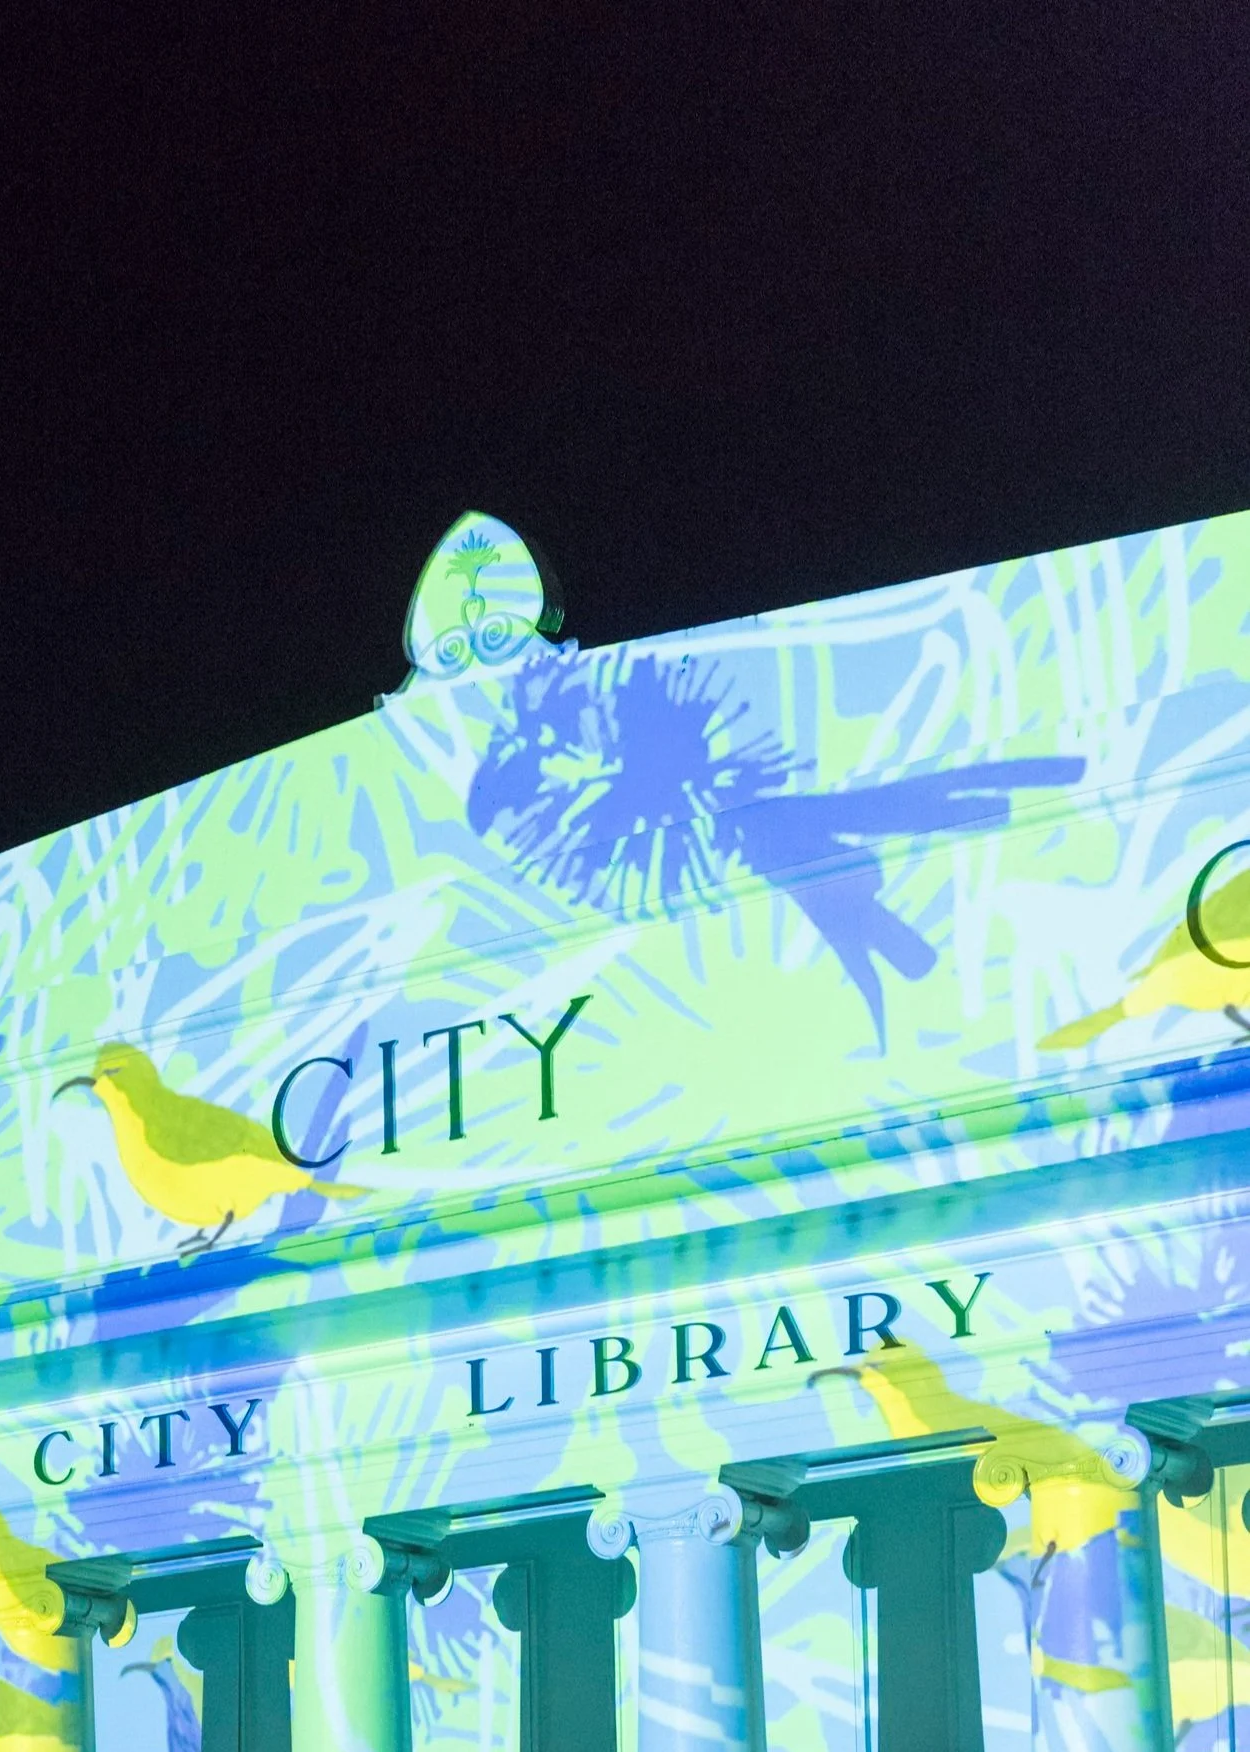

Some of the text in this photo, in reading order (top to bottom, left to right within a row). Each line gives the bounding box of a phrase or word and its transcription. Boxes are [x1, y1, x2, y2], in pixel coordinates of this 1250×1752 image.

[271, 995, 594, 1169] CITY
[33, 1272, 994, 1486] CITY LIBRARY
